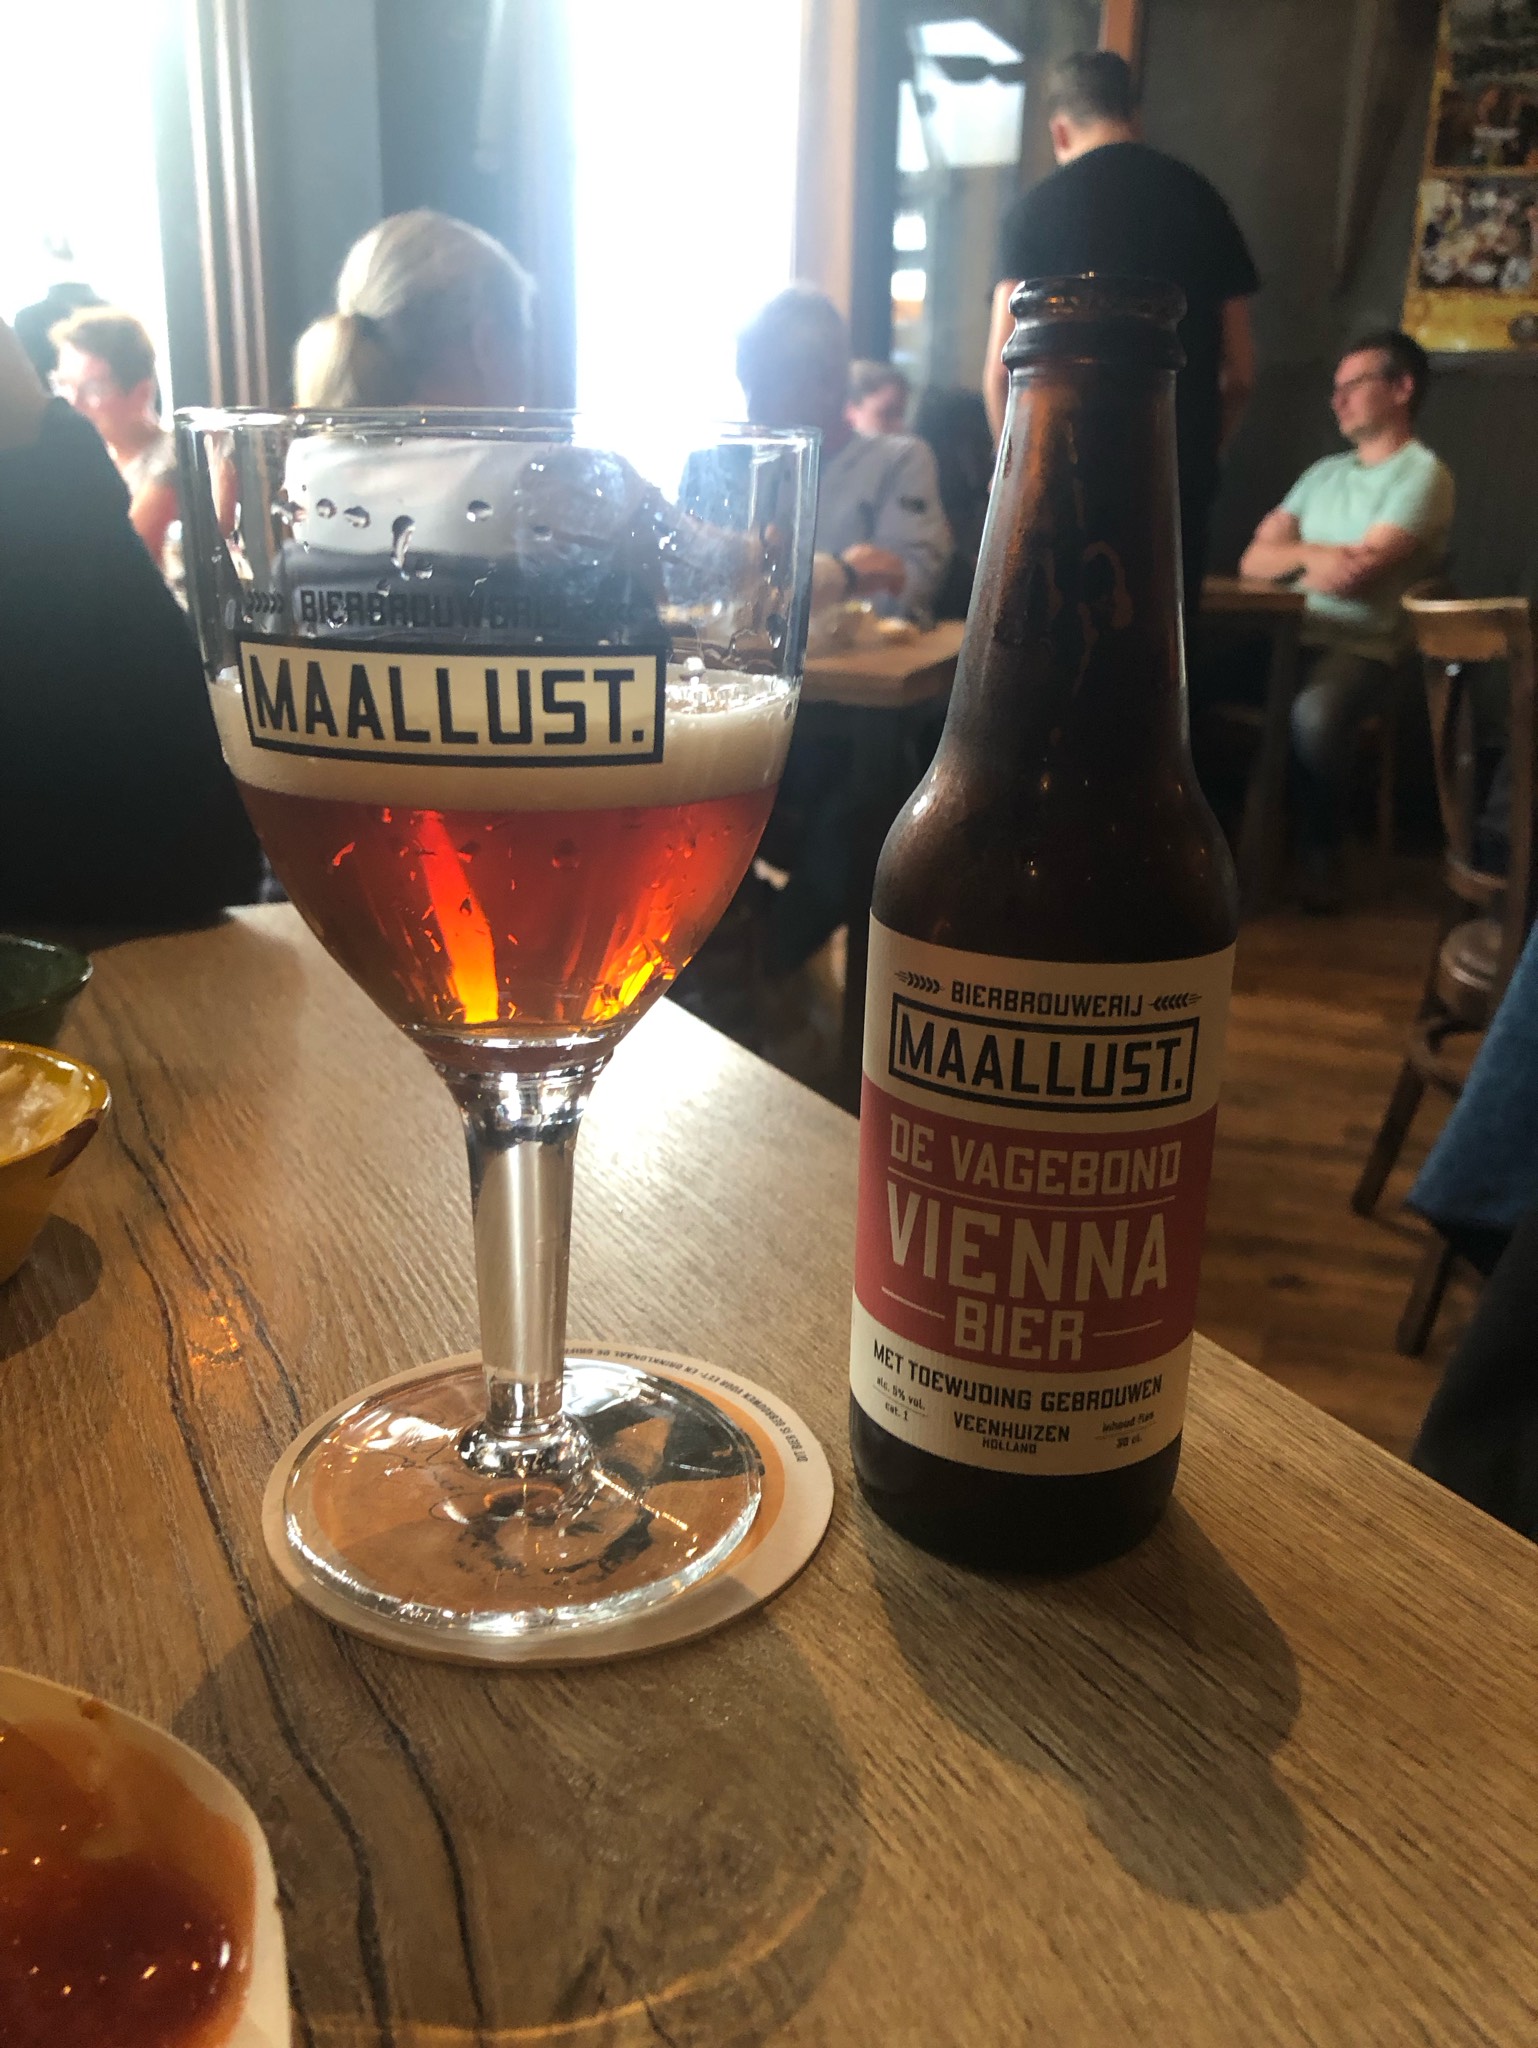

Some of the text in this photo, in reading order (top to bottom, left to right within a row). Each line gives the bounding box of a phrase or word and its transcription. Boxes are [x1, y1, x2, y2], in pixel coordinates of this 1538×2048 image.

[249, 653, 645, 745] MAALLUST.
[951, 980, 1143, 1018] BIERBROUWERIJ
[899, 1012, 1182, 1097] MAALLUST.
[890, 1113, 1182, 1196] DE VAGEBOND
[887, 1180, 1167, 1301] VIENNA
[954, 1296, 1085, 1361] BIER
[874, 1338, 1163, 1412] MET TOEWIJDING GEBROUWEN
[953, 1410, 1070, 1443] VEENHUIZEN
[982, 1437, 1037, 1455] HOLLAND
